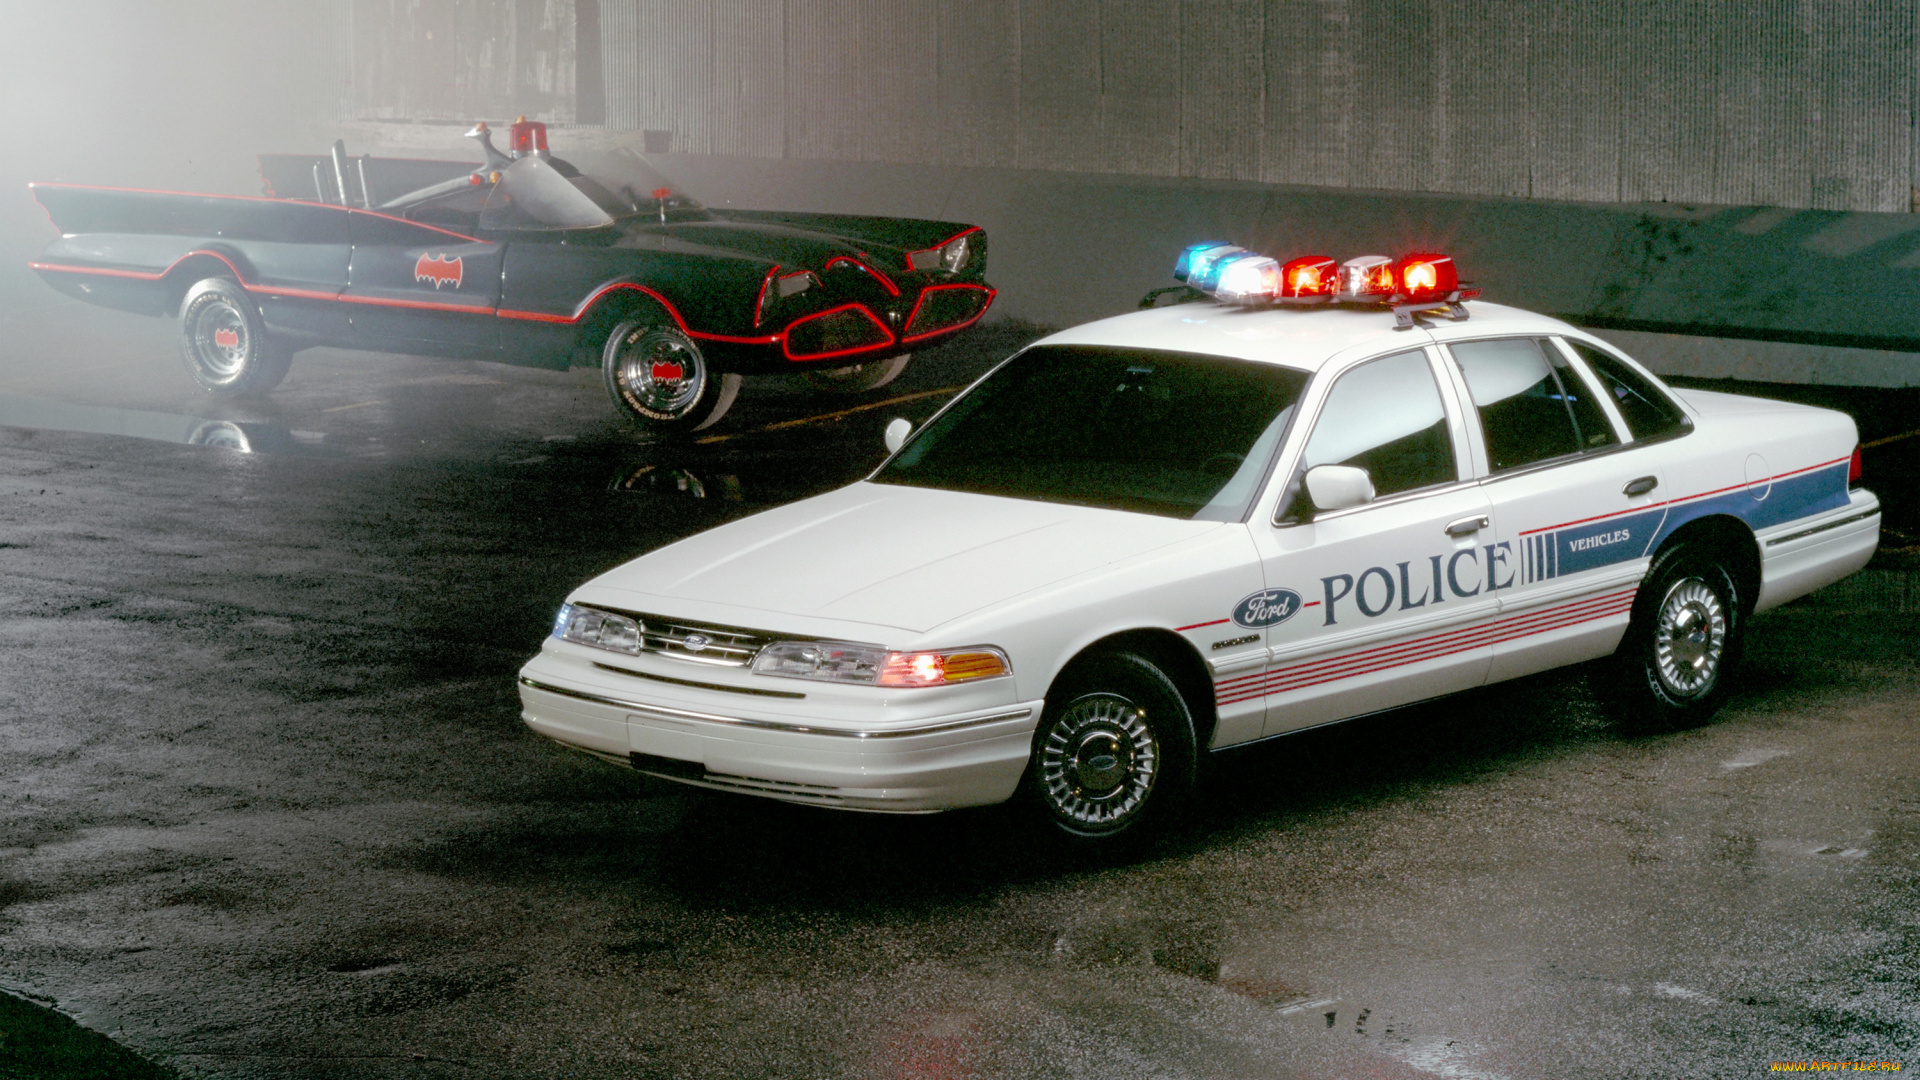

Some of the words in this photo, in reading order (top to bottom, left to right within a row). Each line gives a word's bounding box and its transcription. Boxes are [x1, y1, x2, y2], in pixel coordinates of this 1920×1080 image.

[623, 391, 676, 420] THOMPSON
[1569, 528, 1631, 553] VEHICLES
[1321, 541, 1516, 627] POLICE
[1244, 593, 1290, 624] Ford
